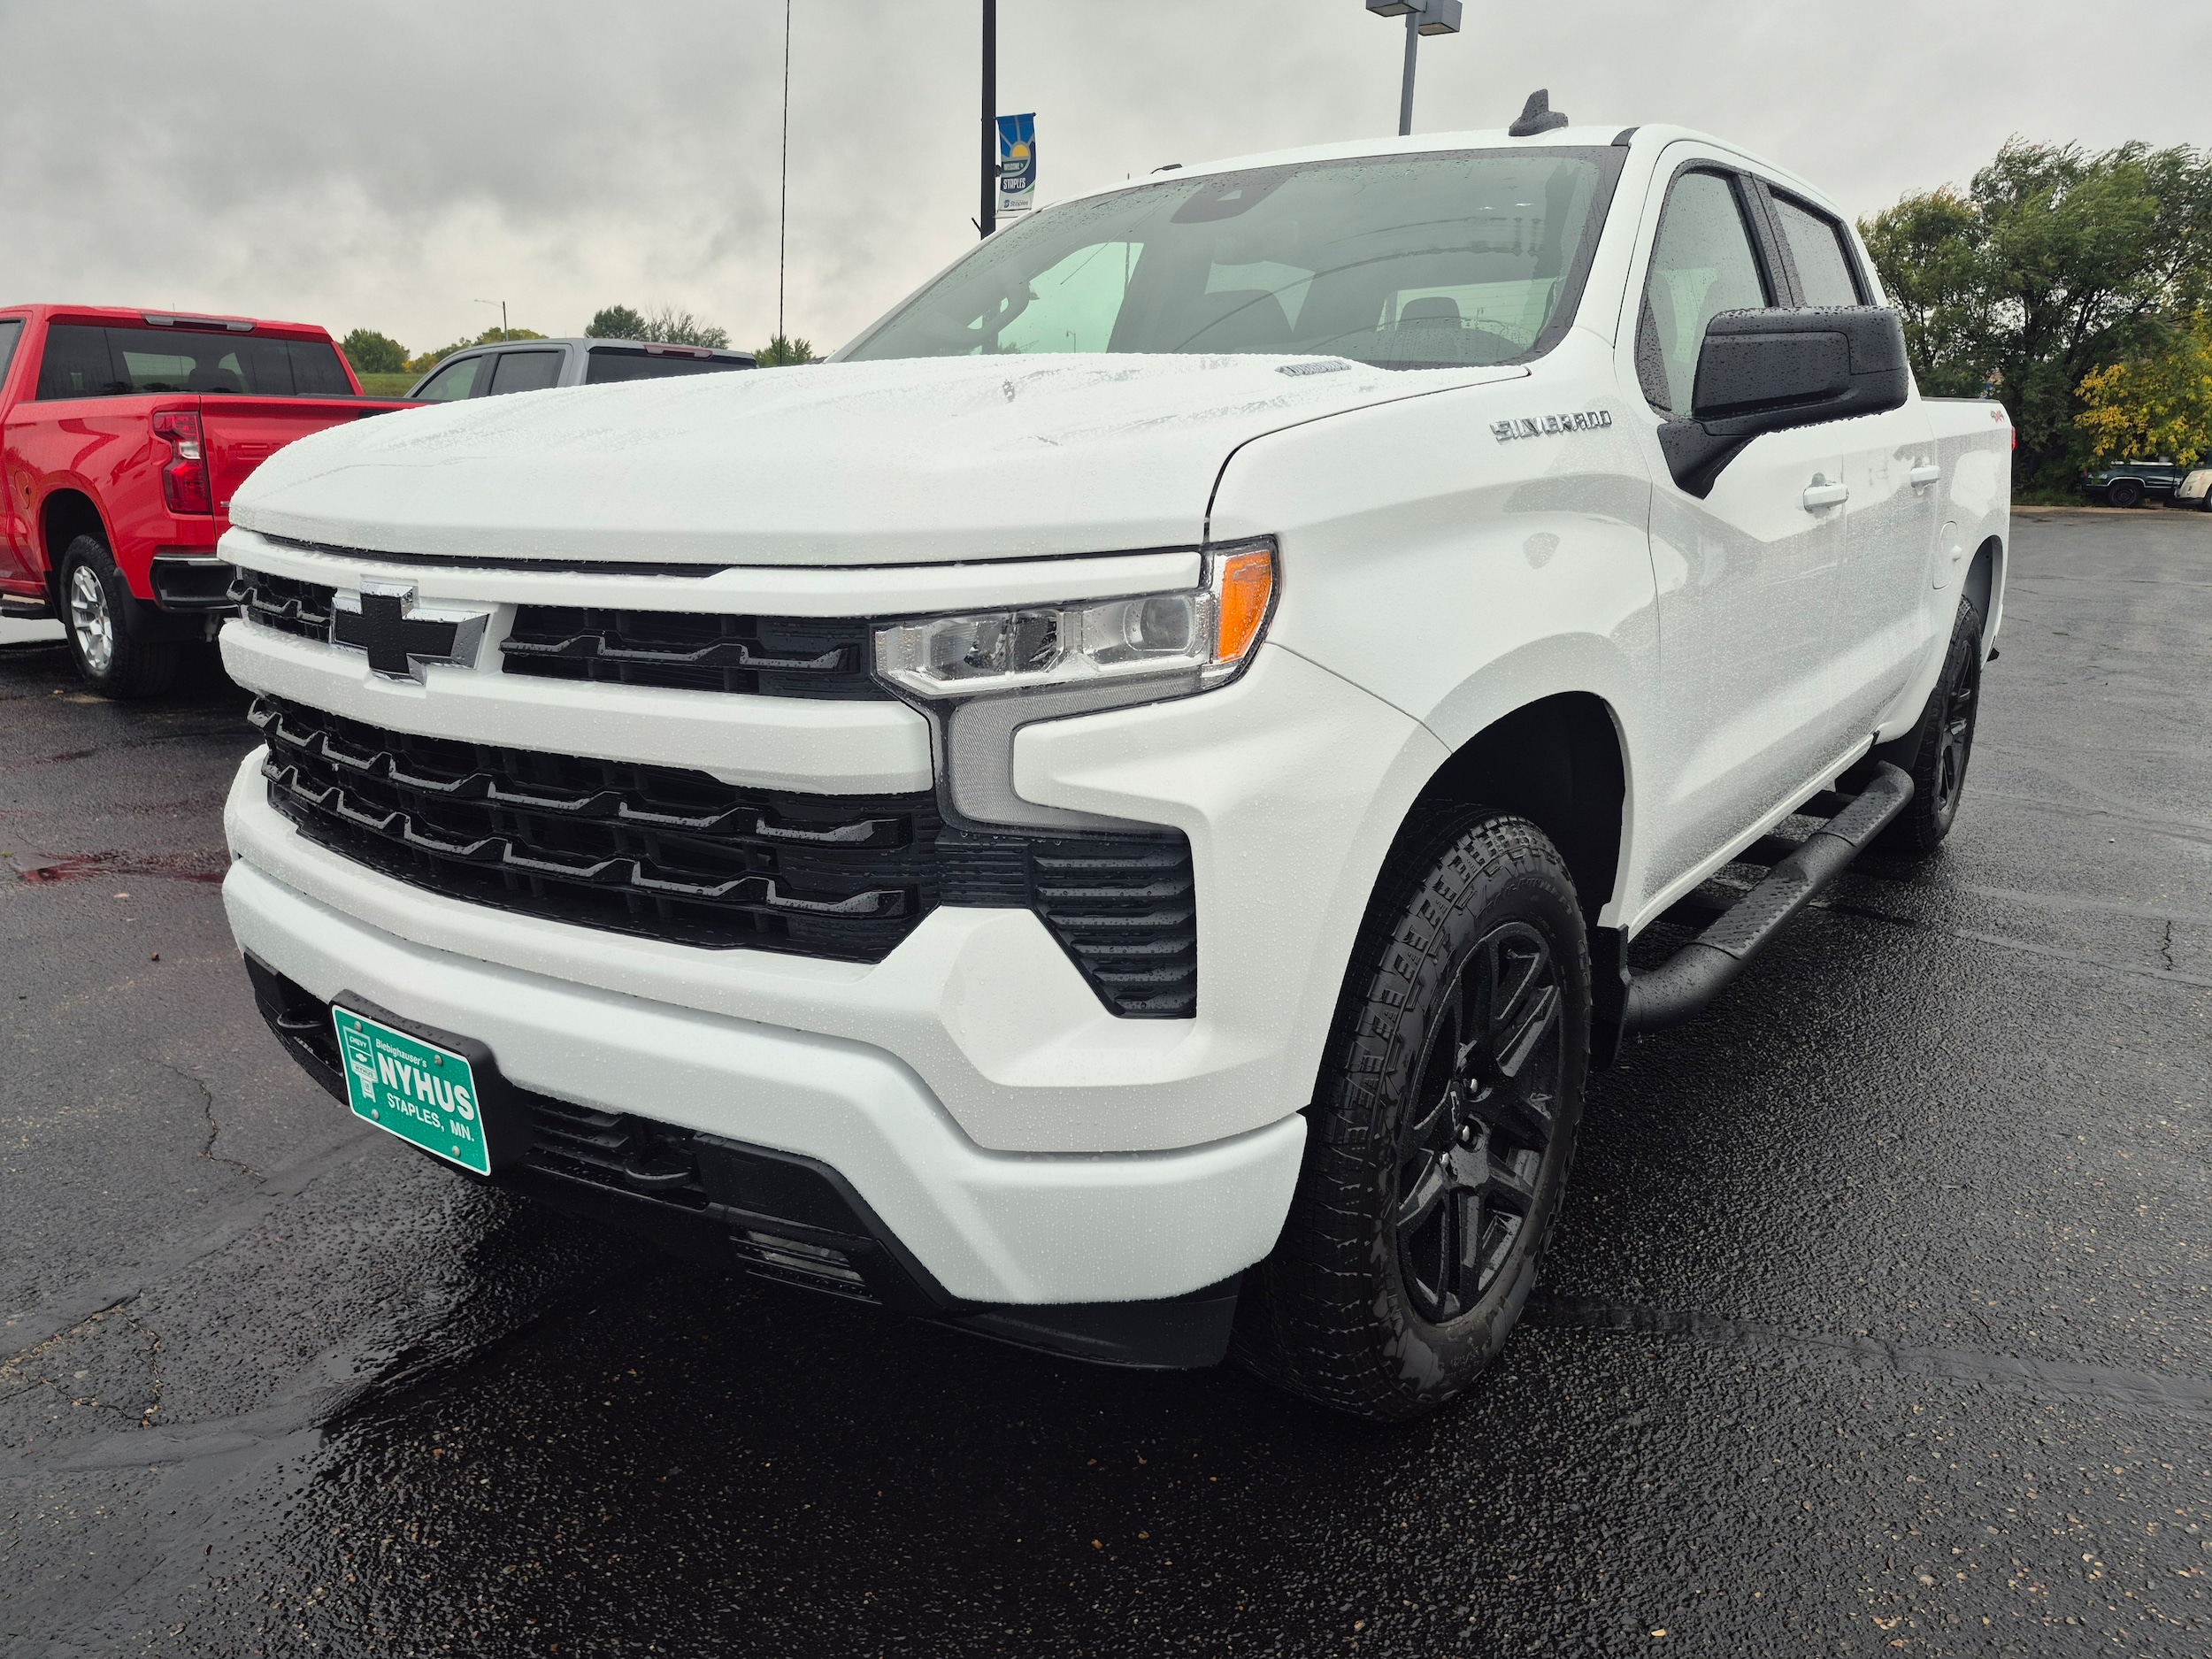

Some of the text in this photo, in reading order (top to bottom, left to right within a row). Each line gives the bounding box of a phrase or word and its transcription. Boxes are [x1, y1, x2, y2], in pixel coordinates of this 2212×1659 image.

[1002, 178, 1026, 189] STAPLES
[1489, 410, 1612, 442] SILVERADO
[349, 1036, 367, 1048] CHEVY
[375, 1038, 427, 1068] Biebighauser's
[377, 1052, 475, 1121] NYHUS
[387, 1093, 475, 1142] STAPLES, MN.
